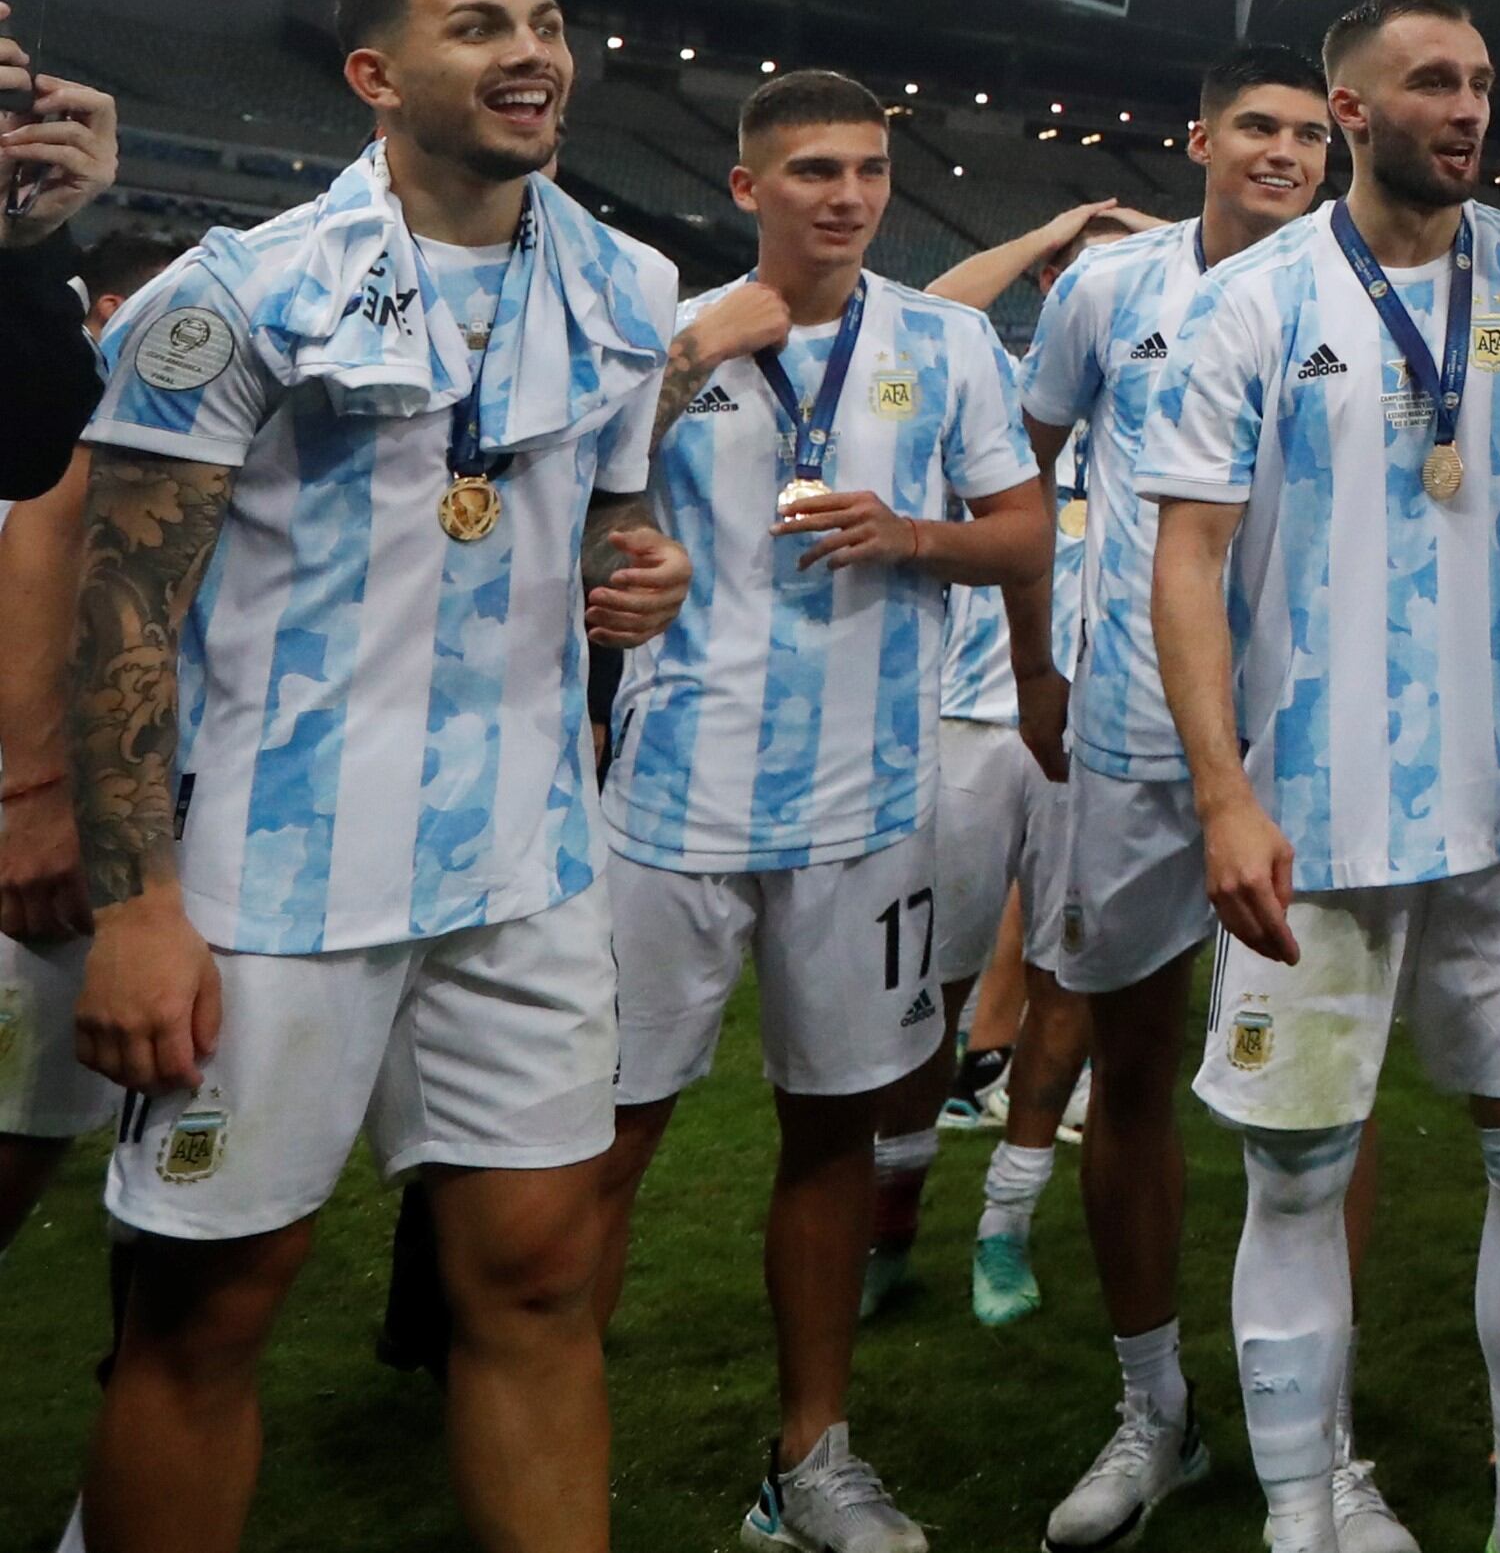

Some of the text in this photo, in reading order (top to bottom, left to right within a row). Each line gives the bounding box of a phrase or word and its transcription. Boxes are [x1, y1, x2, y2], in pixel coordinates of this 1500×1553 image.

[1130, 348, 1168, 359] adida
[151, 372, 175, 385] FINAL
[1298, 361, 1348, 379] adidas
[881, 382, 910, 406] AFA
[686, 402, 739, 414] adidas
[875, 886, 934, 990] 17
[171, 1130, 209, 1164] AFA
